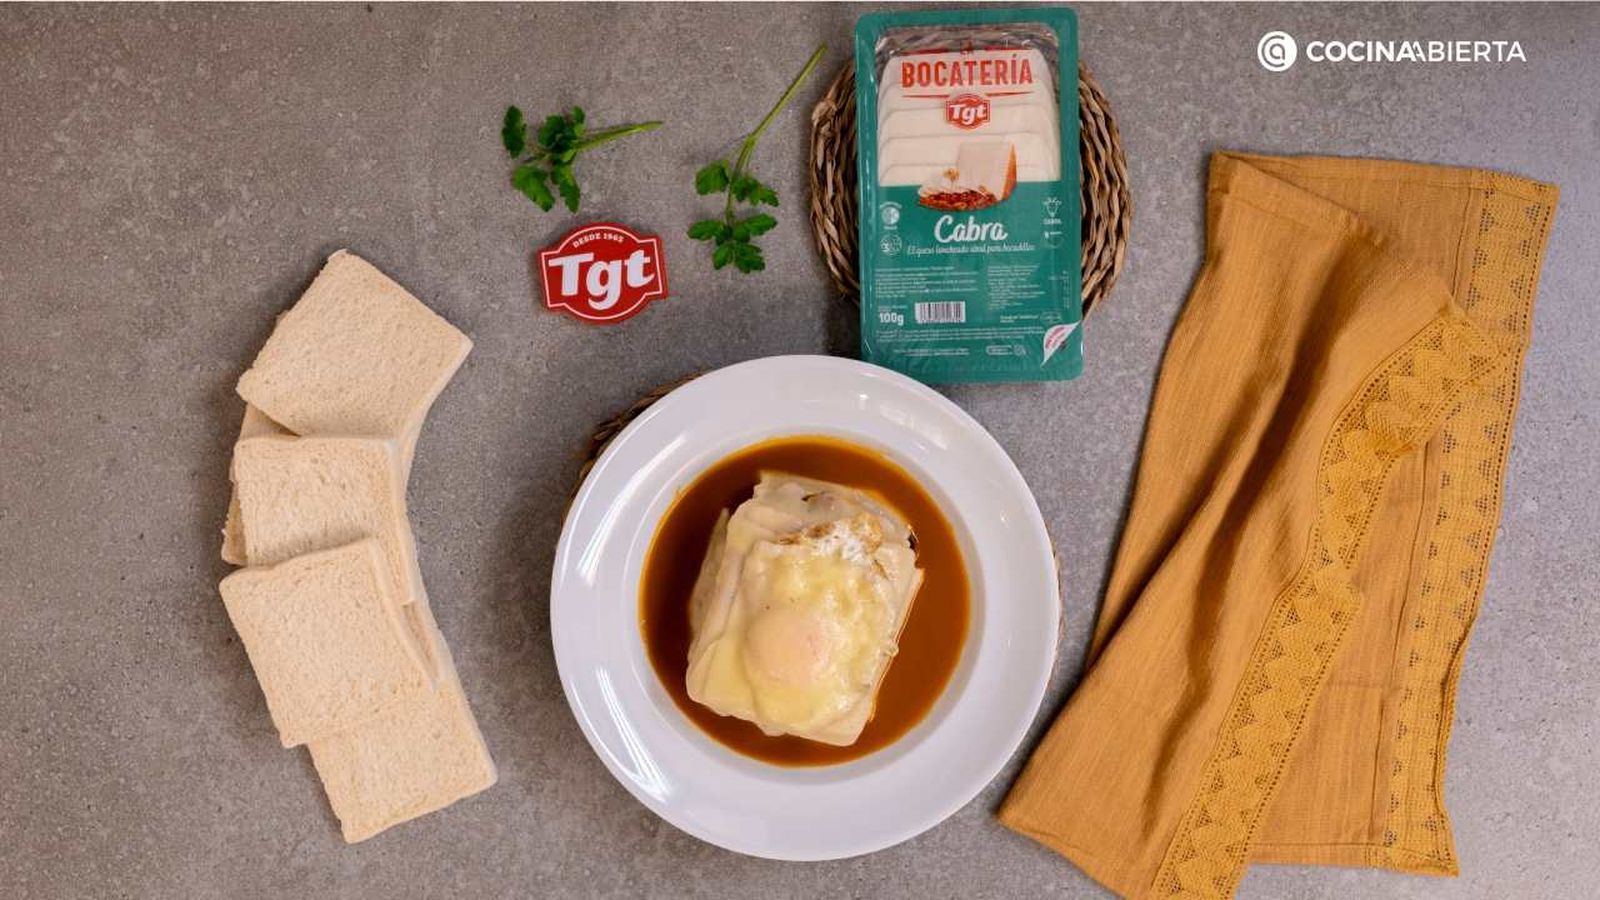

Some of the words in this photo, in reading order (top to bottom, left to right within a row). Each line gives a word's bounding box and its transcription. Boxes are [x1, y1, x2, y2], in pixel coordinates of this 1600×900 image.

[901, 53, 1033, 88] BOCATERÍA
[950, 103, 987, 125] Tgt
[573, 232, 601, 249] DESDE
[934, 214, 1008, 243] Cabra
[548, 249, 655, 310] Tgt
[879, 312, 904, 326] 100g
